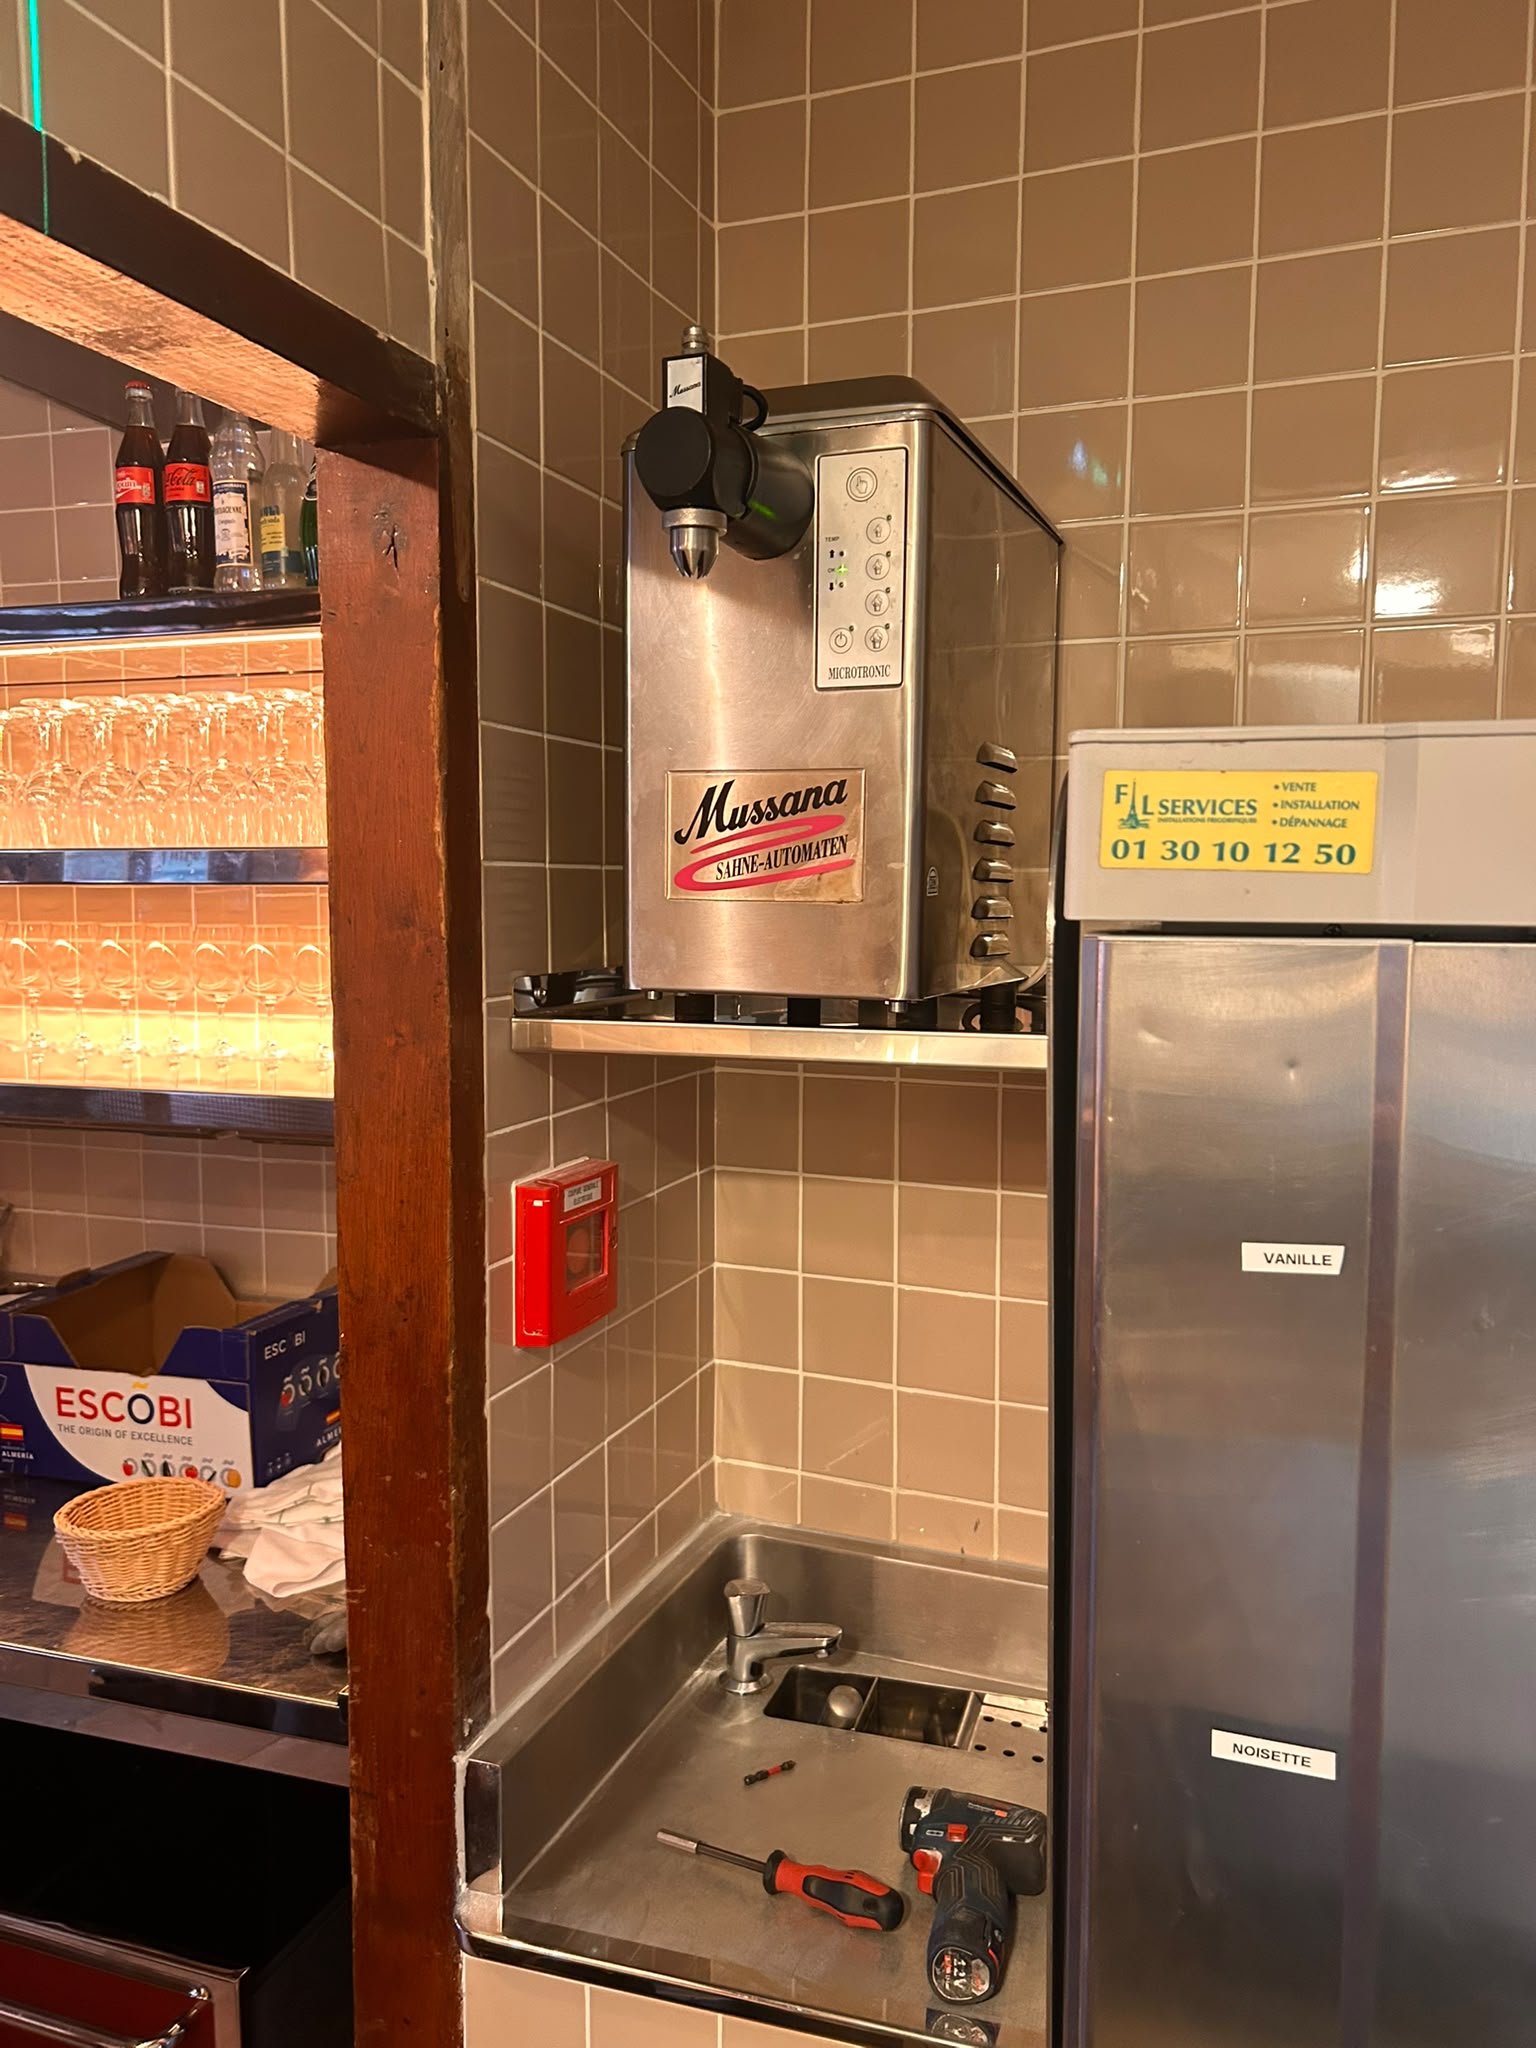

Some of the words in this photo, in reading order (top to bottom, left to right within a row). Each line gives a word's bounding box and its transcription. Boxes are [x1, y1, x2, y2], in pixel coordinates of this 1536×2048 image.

[825, 535, 840, 543] TEMP
[828, 664, 891, 681] MICROTRONIC
[1282, 782, 1317, 793] VENTE
[673, 778, 848, 846] Mussana
[1157, 798, 1258, 816] SERVICES
[1280, 800, 1360, 811] INSTALLATION
[1279, 815, 1348, 829] DÉPANNAGE
[715, 834, 849, 881] SAHNE-AUTOMATEN
[1111, 838, 1147, 861] 01
[1160, 839, 1200, 862] 30
[1212, 840, 1250, 863] 10
[1263, 842, 1301, 865] 12
[1313, 843, 1357, 866] 50
[1264, 1252, 1331, 1267] VANILLE
[57, 1422, 76, 1434] THE
[79, 1426, 112, 1439] ORIGIN
[115, 1429, 128, 1440] OF
[131, 1431, 194, 1446] EXCELLENCE
[1232, 1742, 1312, 1768] NOISETTE
